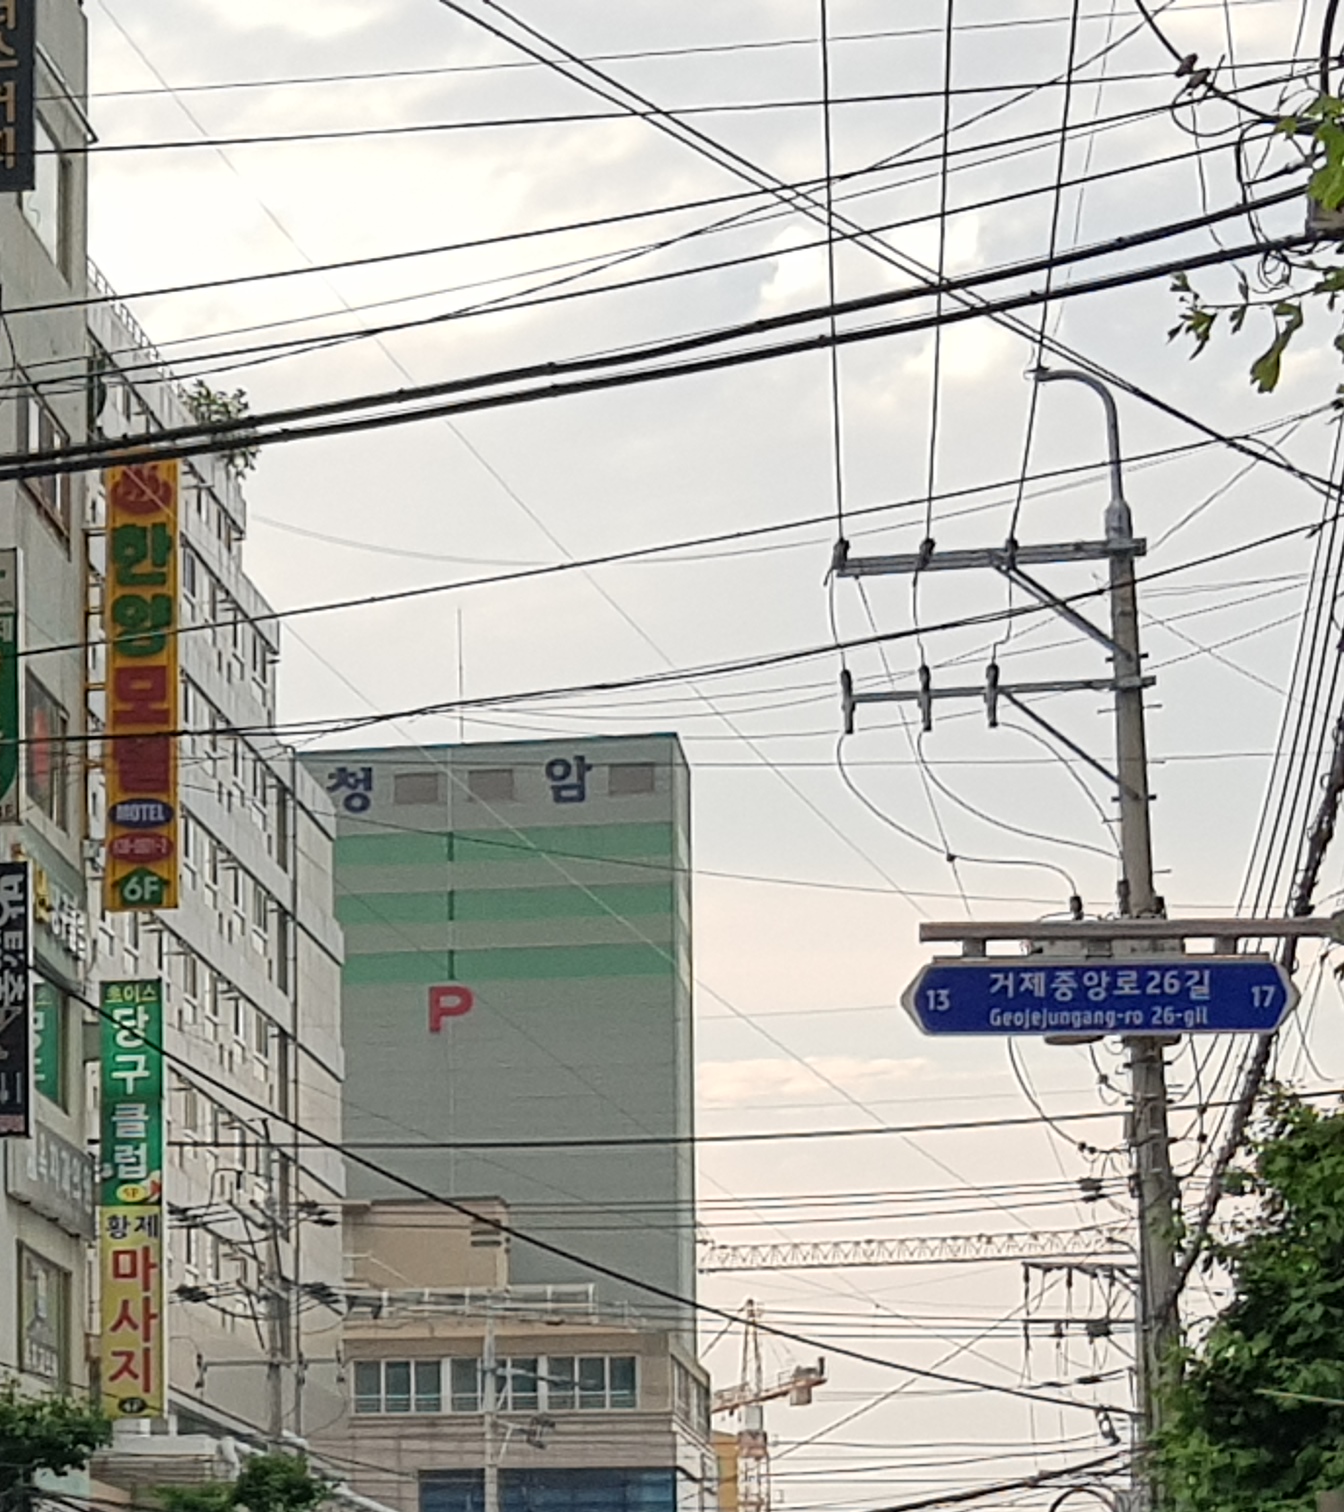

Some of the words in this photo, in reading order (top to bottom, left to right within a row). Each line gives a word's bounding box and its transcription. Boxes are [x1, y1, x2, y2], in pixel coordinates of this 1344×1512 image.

[116, 803, 165, 821] MOTEL
[123, 876, 159, 901] 6F
[989, 969, 1211, 1001] 거제중앙로26길
[1251, 986, 1275, 1008] 17
[428, 986, 474, 1033] P
[926, 989, 951, 1011] 13
[989, 1008, 1143, 1029] Geojejungang-ro
[1152, 1007, 1209, 1027] 26-gil
[111, 1005, 150, 1180] 당구클럽
[106, 1214, 159, 1239] 황제
[109, 1245, 159, 1394] 마사지
